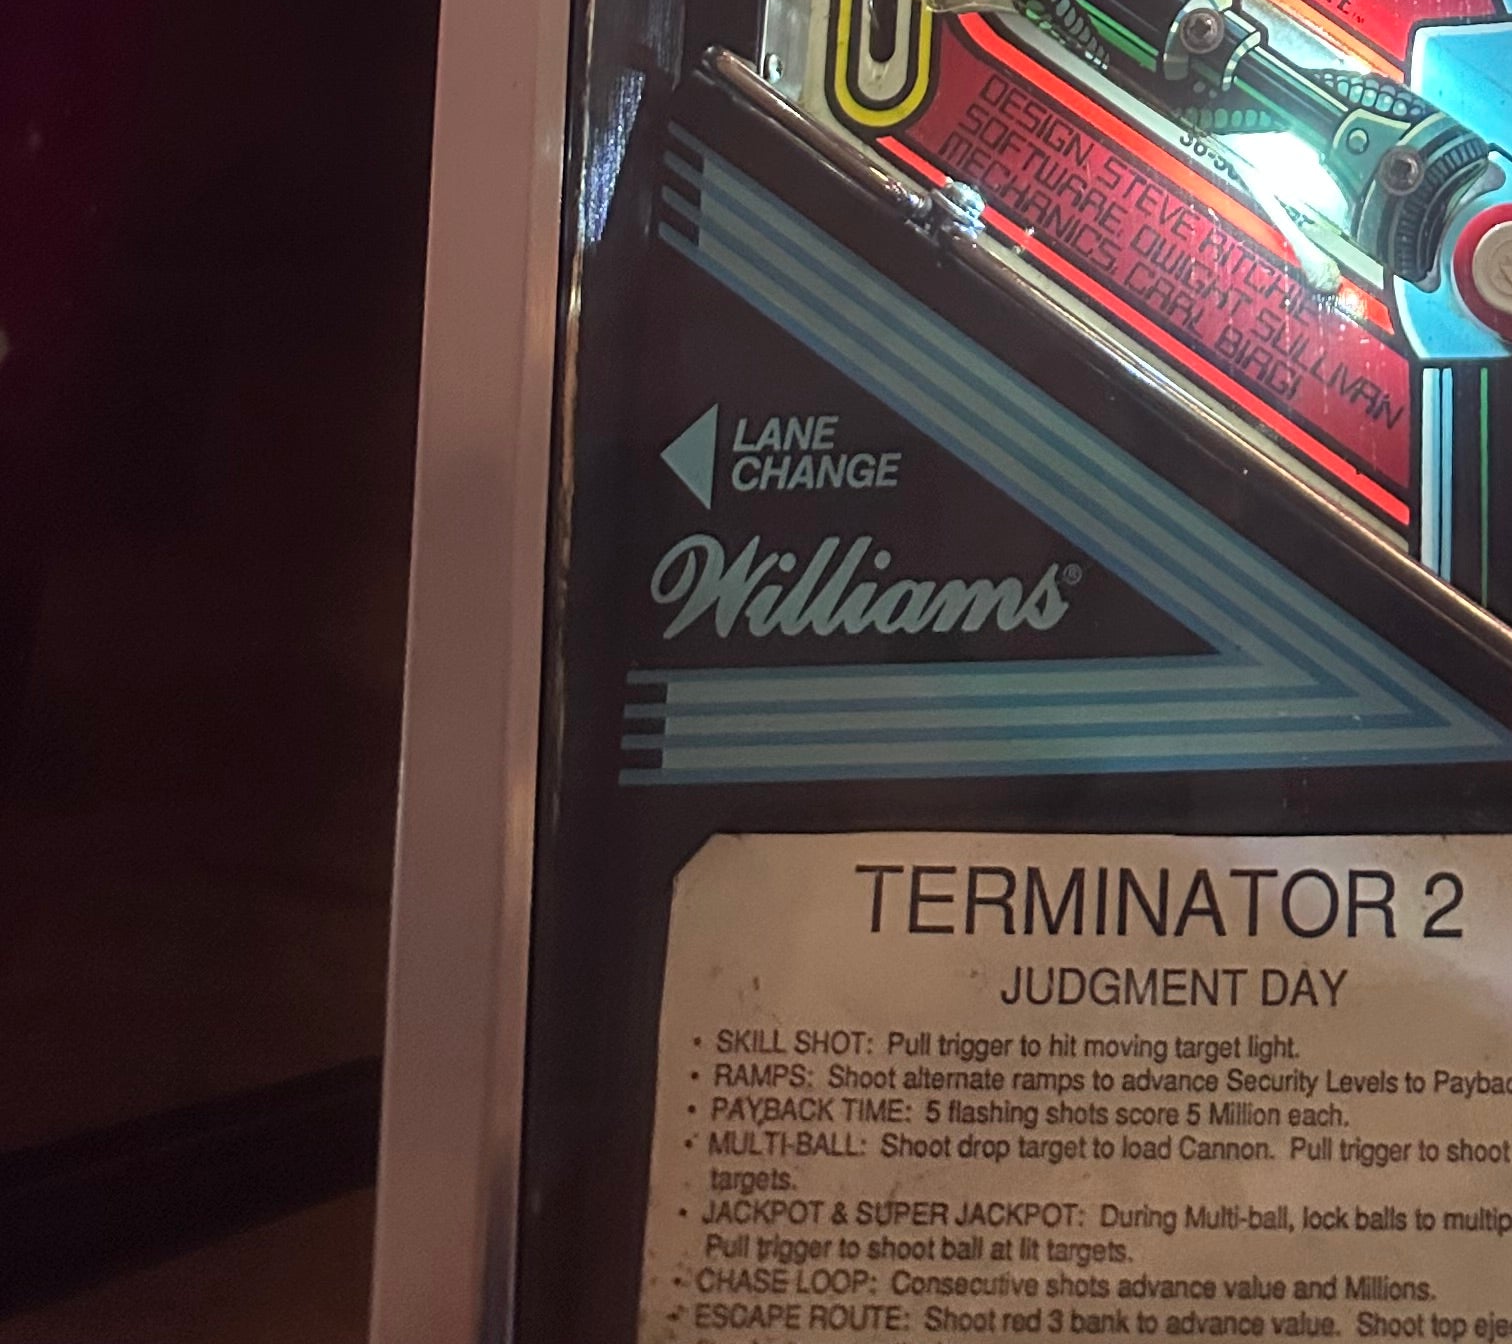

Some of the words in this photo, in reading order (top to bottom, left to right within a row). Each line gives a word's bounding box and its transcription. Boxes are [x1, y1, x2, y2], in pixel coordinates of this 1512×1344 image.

[1096, 155, 1202, 242] STEVE
[1199, 228, 1318, 328] RITCHIE
[1123, 260, 1204, 339] CARL
[1214, 323, 1303, 401] BIAGI
[1129, 223, 1252, 314] DWIGHT
[1250, 306, 1405, 431] SULLIVAN
[732, 414, 840, 454] LANE
[731, 452, 902, 492] CHANGE
[650, 533, 1074, 640] Williams
[856, 864, 1399, 940] TERMINATOR
[1421, 872, 1467, 942] 2
[1000, 967, 1248, 1009] JUDGMENT
[1259, 968, 1349, 1011] DAY
[717, 1029, 787, 1054] SKILL
[794, 1030, 874, 1055] SHOT:
[888, 1031, 931, 1058] Pull
[938, 1032, 1013, 1062] trigger
[1020, 1034, 1042, 1058] to
[1049, 1033, 1077, 1058] hit
[1084, 1034, 1168, 1063] moving
[1174, 1036, 1241, 1064] target
[1248, 1035, 1300, 1064] light.
[714, 1063, 813, 1088] RAMPS:
[828, 1065, 896, 1090] Shoot
[903, 1066, 1004, 1091] alternate
[1012, 1071, 1085, 1095] ramps
[1093, 1070, 1115, 1092] to
[1122, 1069, 1219, 1093] advance
[1226, 1069, 1319, 1098] Security
[1326, 1070, 1399, 1095] Levels
[1405, 1071, 1426, 1095] to
[711, 1097, 833, 1124] PAYBACK
[841, 1098, 912, 1125] TIME:
[924, 1099, 942, 1125] 5
[948, 1099, 1038, 1129] flashing
[1045, 1103, 1109, 1127] shots
[1115, 1107, 1179, 1127] score
[1186, 1103, 1201, 1127] 5
[1208, 1102, 1280, 1127] Million
[1288, 1104, 1349, 1128] each.
[708, 1130, 867, 1158] MULTI-BALL:
[881, 1132, 952, 1159] Shoot
[957, 1133, 1010, 1163] drop
[1018, 1136, 1086, 1164] target
[1093, 1137, 1115, 1161] to
[1122, 1135, 1172, 1161] load
[1178, 1135, 1275, 1161] Cannon.
[1290, 1136, 1333, 1162] Pull
[1340, 1137, 1412, 1167] trigger
[1418, 1138, 1440, 1163] to
[1446, 1138, 1511, 1163] shoot
[709, 1167, 797, 1195] targets.
[702, 1199, 825, 1226] JACKPOT
[830, 1200, 849, 1226] &
[855, 1201, 949, 1228] SUPER
[955, 1202, 1085, 1228] JACKPOT:
[1100, 1203, 1177, 1235] During
[1184, 1203, 1295, 1233] Multi-ball,
[1302, 1206, 1350, 1231] lock
[1354, 1206, 1407, 1232] balls
[1415, 1207, 1437, 1232] to
[705, 1233, 749, 1259] Pull
[756, 1234, 832, 1265] trigger
[839, 1237, 860, 1260] to
[867, 1235, 936, 1261] shoot
[942, 1235, 983, 1262] ball
[990, 1238, 1013, 1262] at
[1020, 1238, 1040, 1262] lit
[1047, 1239, 1133, 1268] targets.
